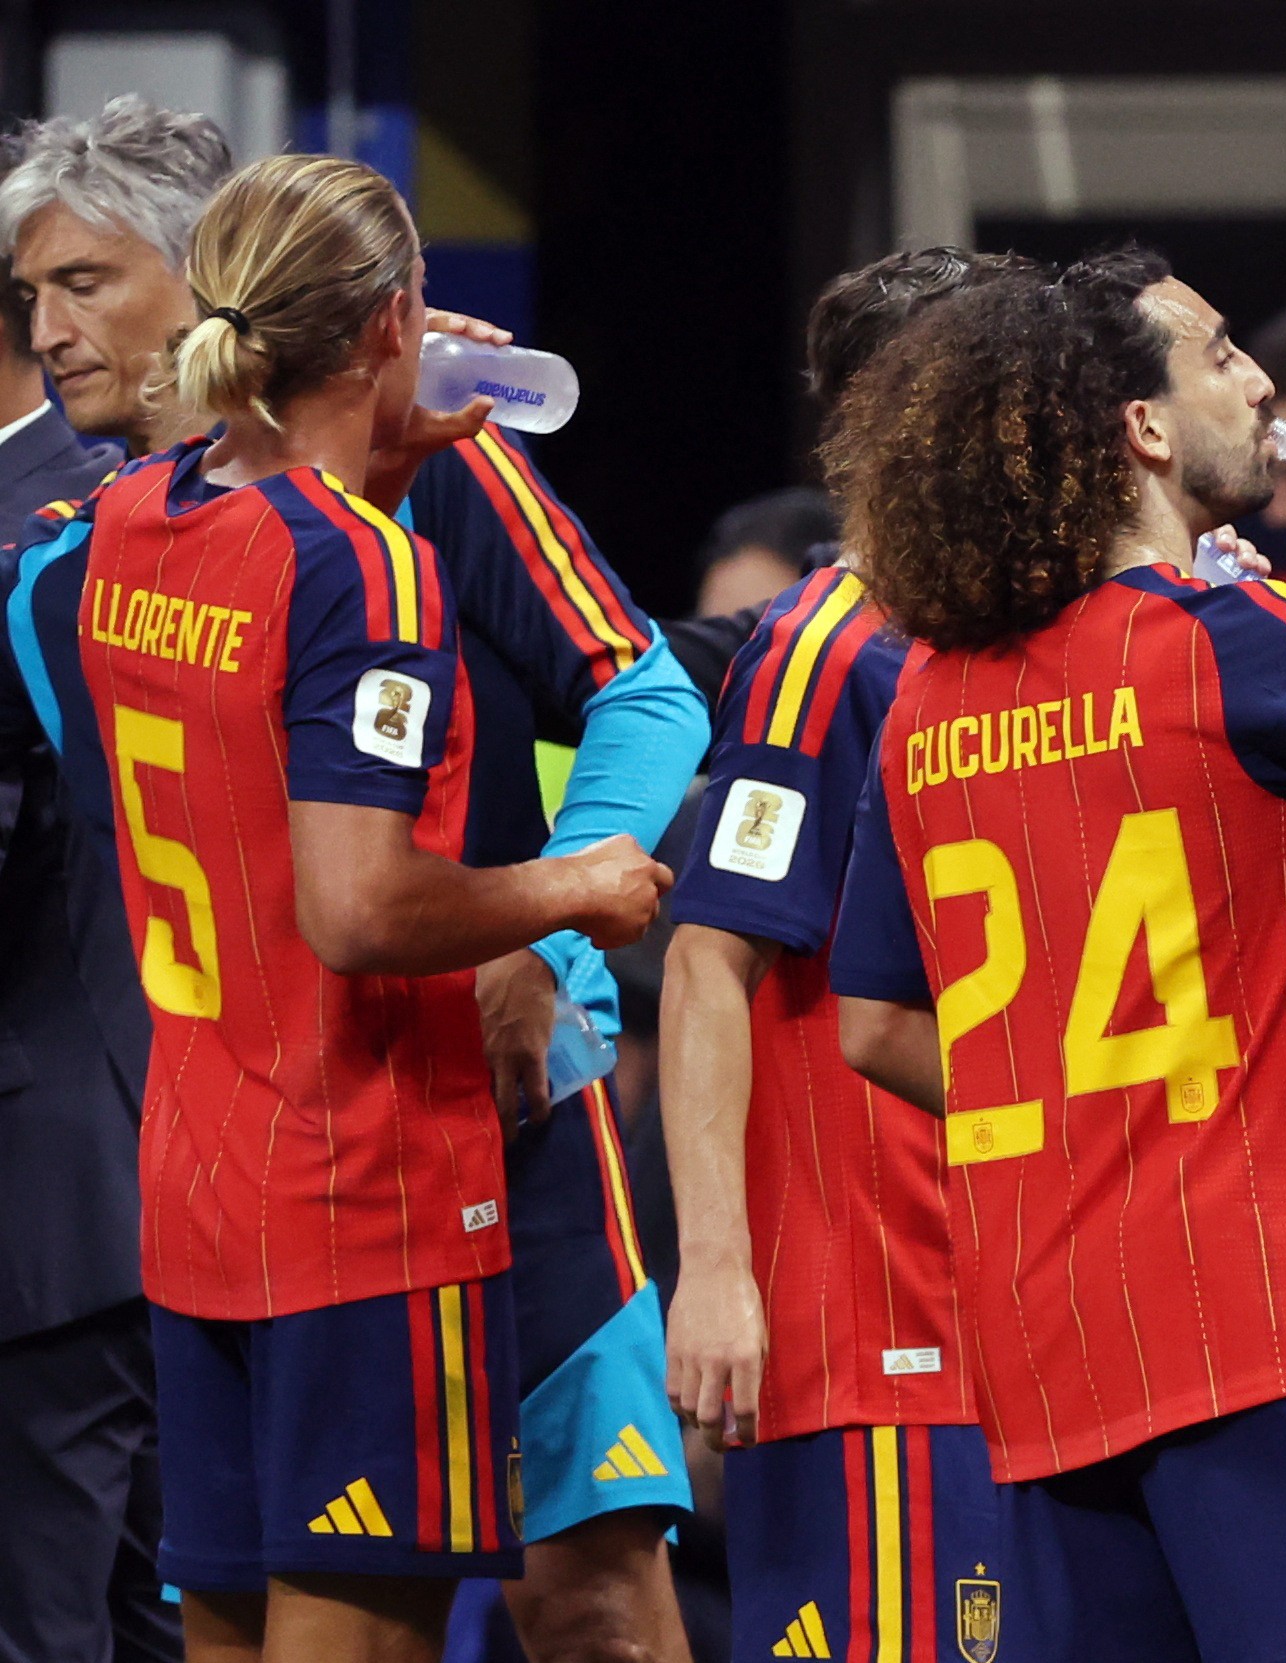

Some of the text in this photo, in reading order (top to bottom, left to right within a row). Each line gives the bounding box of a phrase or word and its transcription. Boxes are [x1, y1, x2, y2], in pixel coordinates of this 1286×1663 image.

[92, 579, 253, 673] LLORENTE
[906, 686, 1144, 796] CUCURELLA
[114, 706, 222, 1019] 5
[922, 808, 1239, 1167] 24
